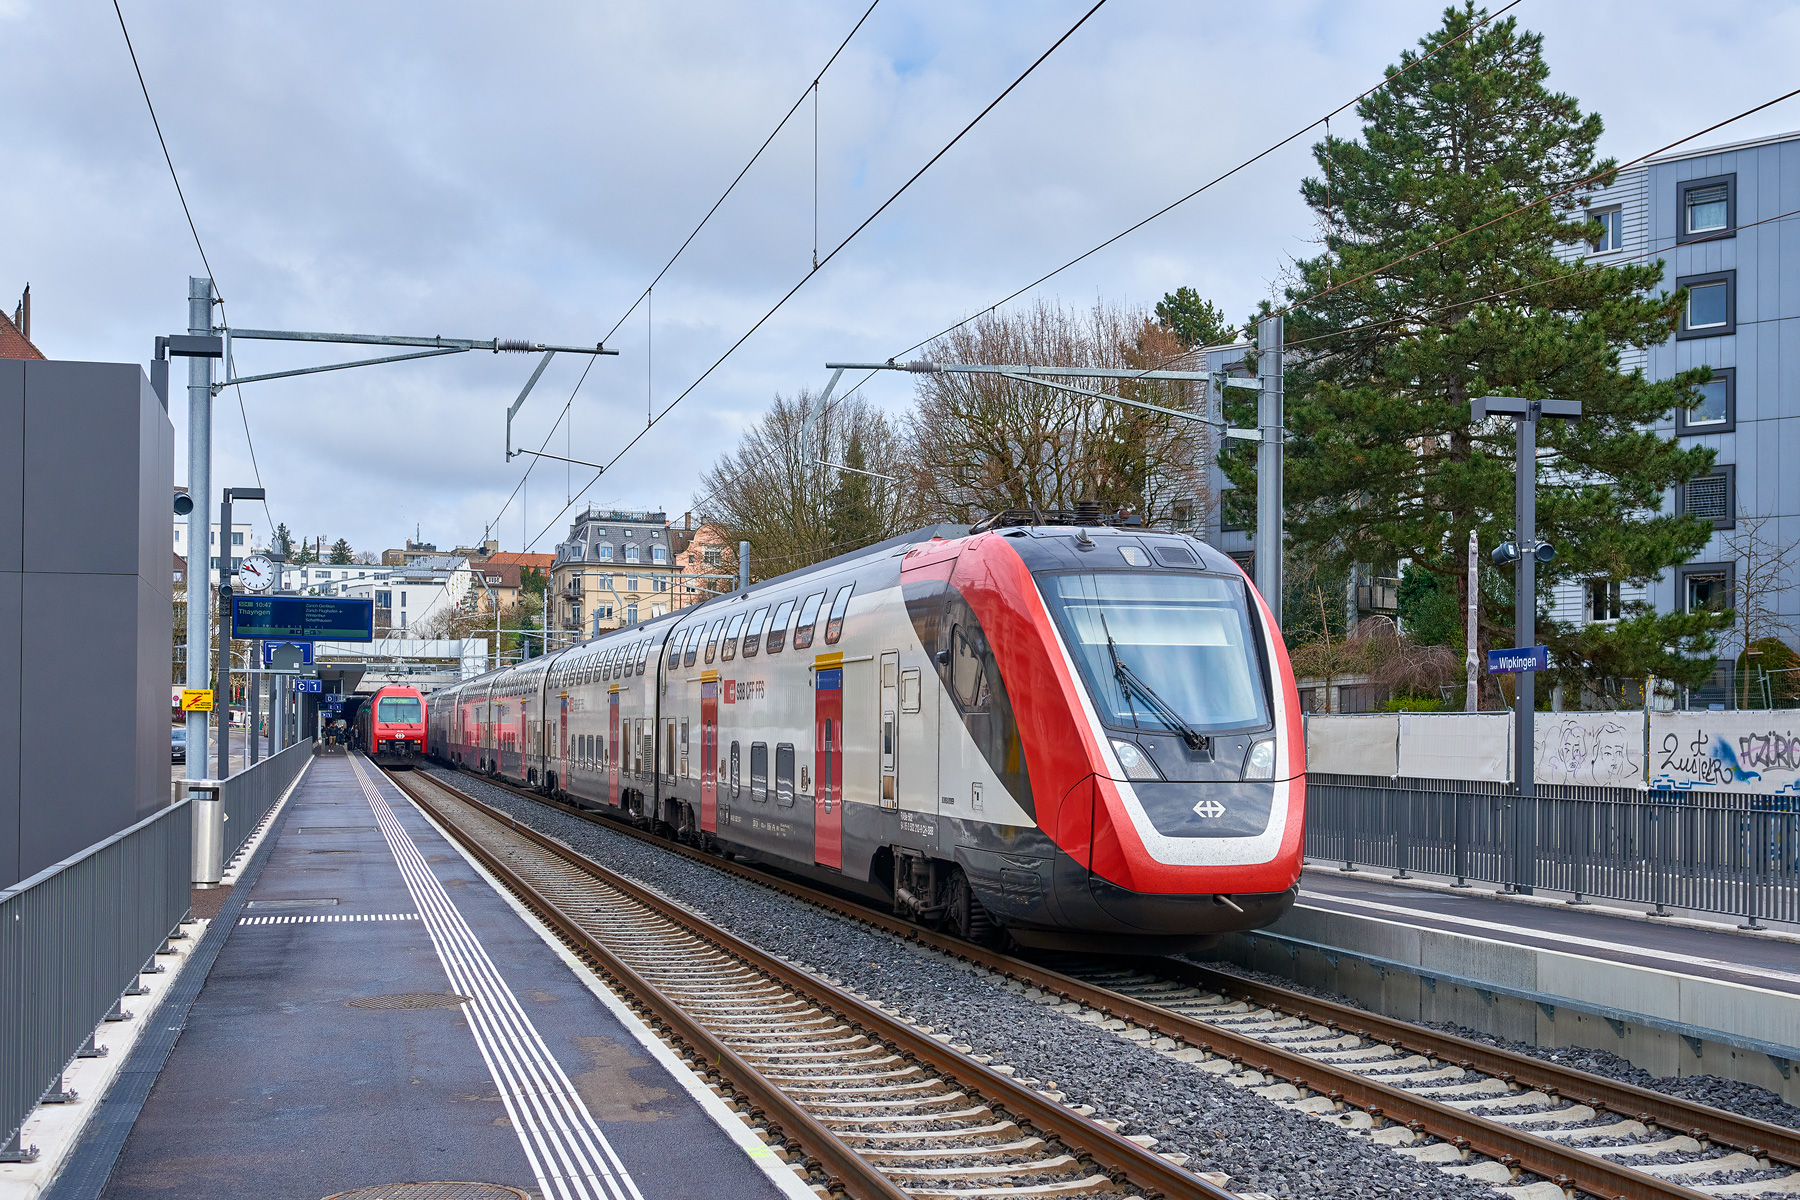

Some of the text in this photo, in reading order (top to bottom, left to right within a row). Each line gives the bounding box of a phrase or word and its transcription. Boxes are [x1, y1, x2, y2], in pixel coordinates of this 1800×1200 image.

[238, 608, 271, 616] Thayngen
[1498, 655, 1537, 671] Wipkingen
[298, 683, 305, 691] C
[312, 683, 317, 691] 1
[736, 682, 746, 701] SBB
